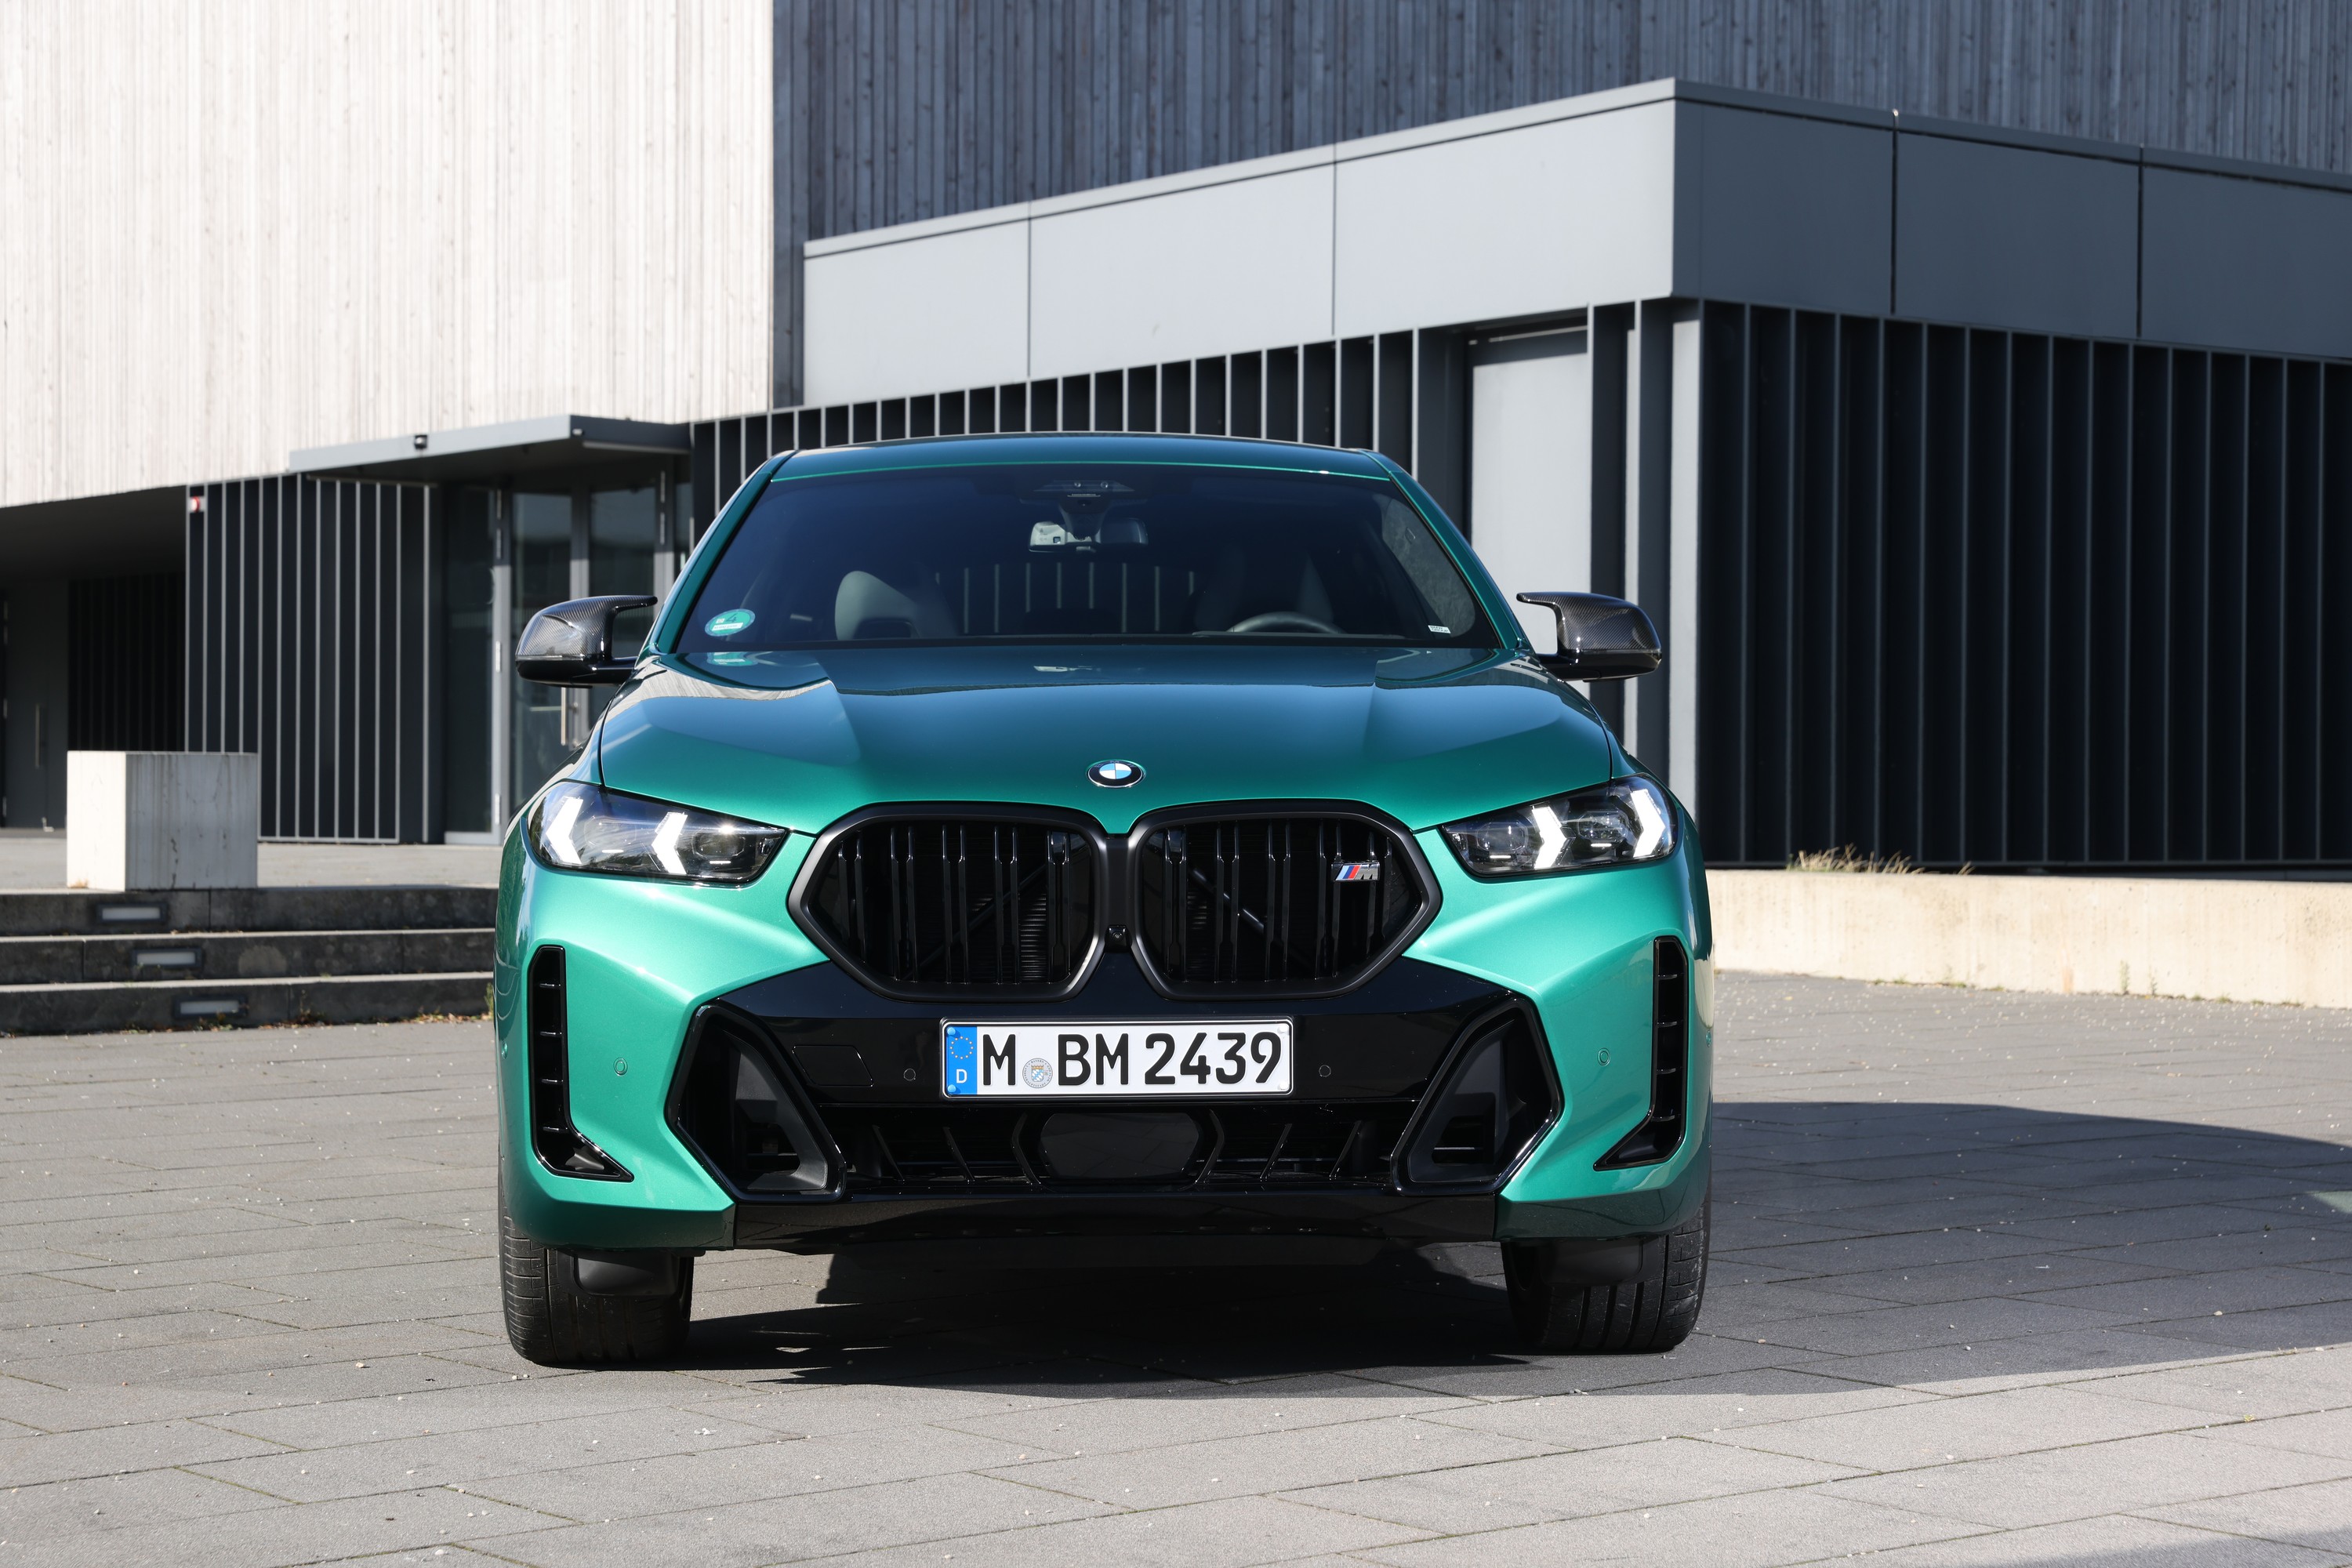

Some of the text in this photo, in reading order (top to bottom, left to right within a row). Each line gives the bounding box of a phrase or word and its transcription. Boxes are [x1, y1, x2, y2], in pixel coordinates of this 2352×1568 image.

[956, 1069, 967, 1083] D
[983, 1033, 1016, 1086] M
[1058, 1033, 1129, 1086] BM
[1145, 1032, 1282, 1085] 2439
